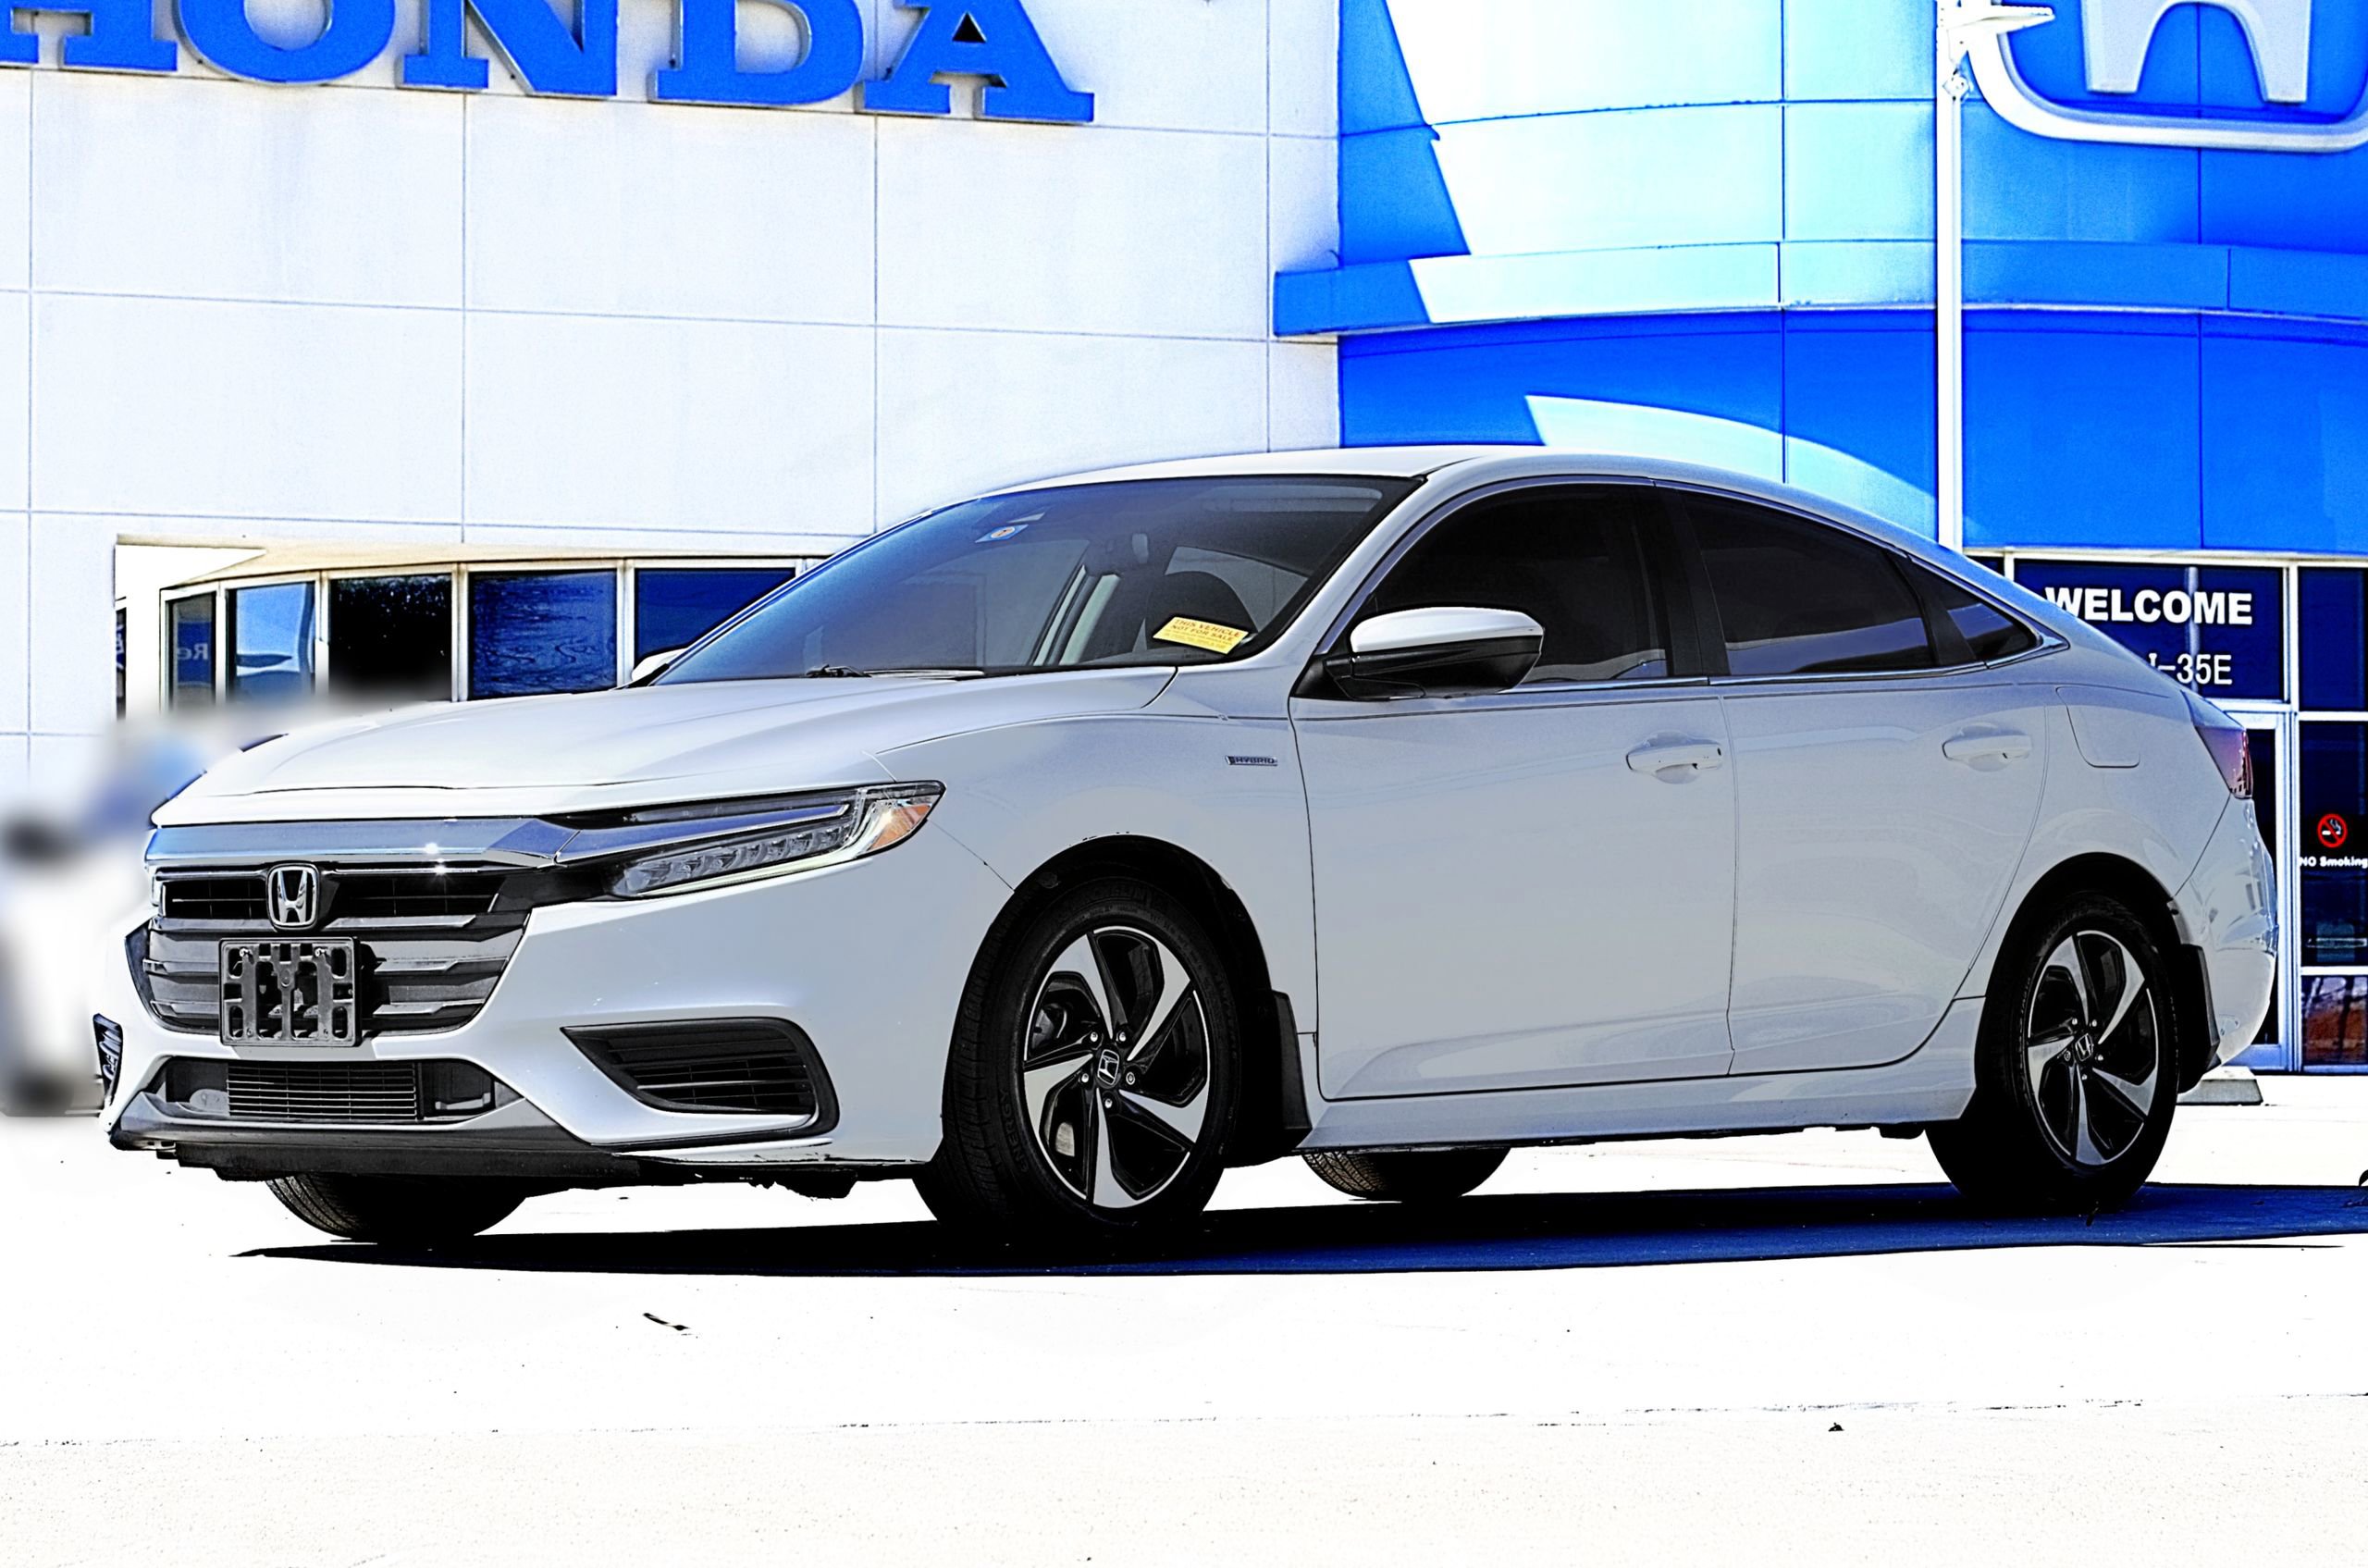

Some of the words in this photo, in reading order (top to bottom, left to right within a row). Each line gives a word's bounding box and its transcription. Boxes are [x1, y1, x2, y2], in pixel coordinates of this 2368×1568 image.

[2044, 587, 2252, 625] WELCOME
[1174, 619, 1196, 627] THIS
[1199, 623, 1241, 637] VEHICLE
[1190, 627, 1208, 636] FOR
[1211, 632, 1234, 641] SALE
[2319, 855, 2368, 870] Smoking
